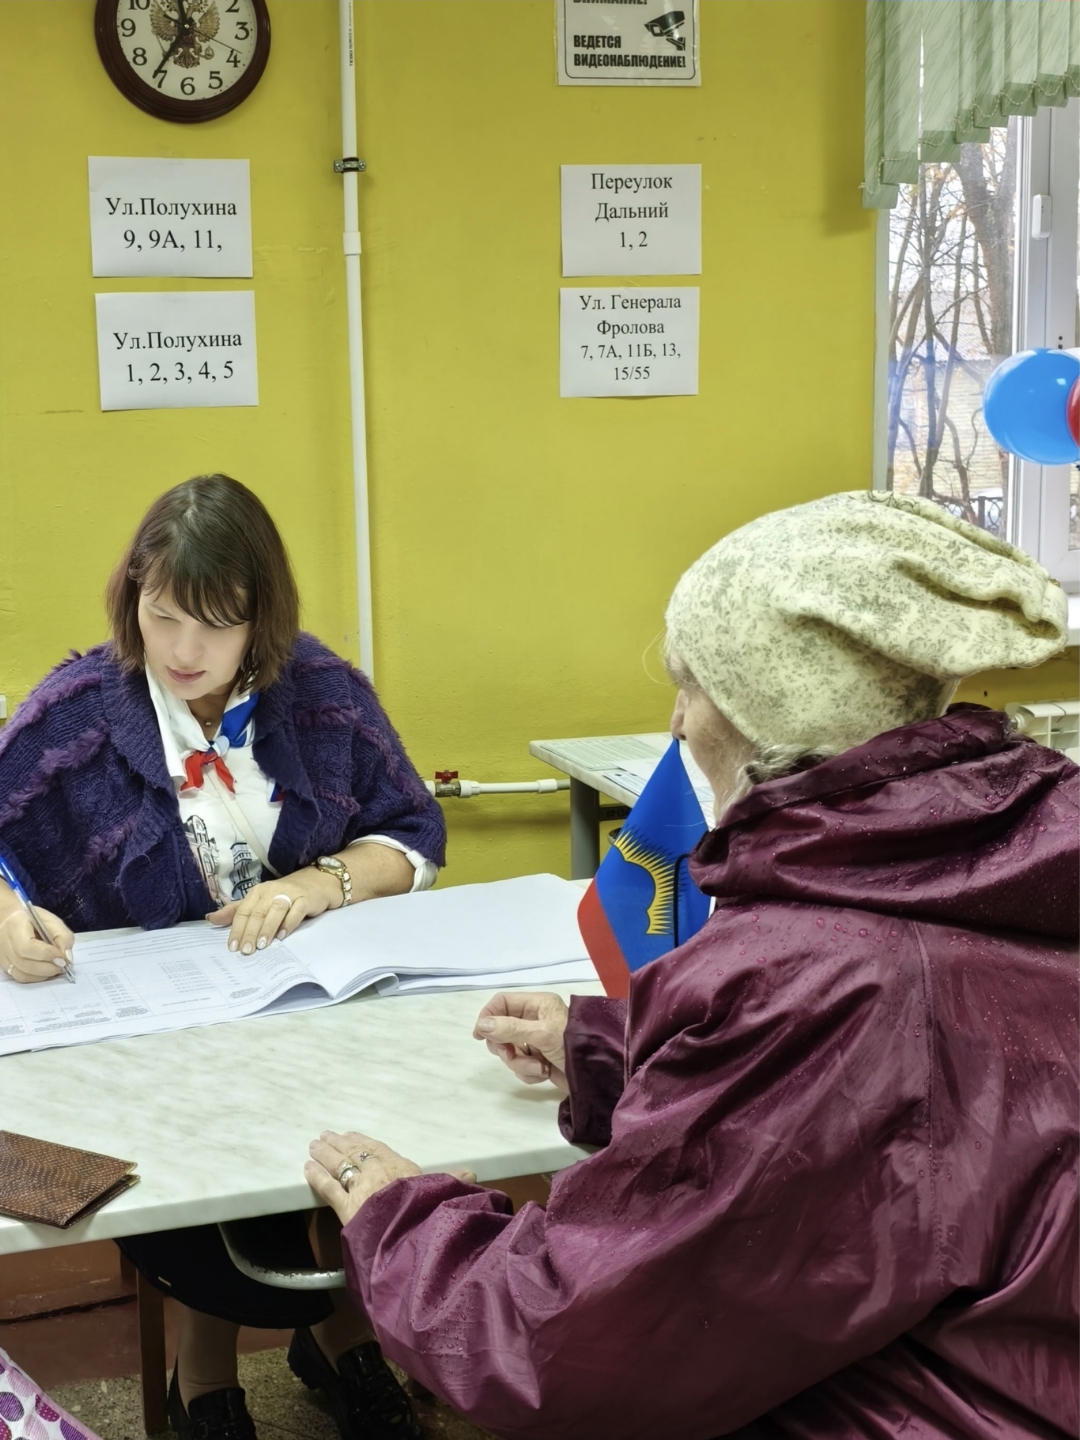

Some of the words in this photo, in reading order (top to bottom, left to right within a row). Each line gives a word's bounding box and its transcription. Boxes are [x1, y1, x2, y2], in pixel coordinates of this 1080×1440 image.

[120, 19, 136, 37] 9
[235, 22, 249, 40] 3
[573, 35, 621, 50] ВЕДЕТСЯ
[132, 48, 147, 65] 8
[226, 50, 241, 67] 4
[574, 54, 686, 69] ВИДЕОНАБЛЮДЕНИЕ!
[180, 77, 195, 95] 6
[208, 71, 223, 89] 5
[591, 173, 672, 194] Переулок
[105, 198, 237, 220] Ул.Полухина
[595, 202, 668, 222] Дальний
[123, 230, 142, 252] 9,
[149, 230, 185, 252] 9А,
[194, 230, 222, 252] 11,
[620, 232, 633, 250] 1,
[638, 231, 648, 247] 2
[579, 295, 605, 310] Ул.
[611, 295, 681, 313] Генерала
[597, 320, 664, 339] Фролова
[113, 332, 242, 352] Ул.Полухина
[581, 346, 593, 360] 7,
[598, 345, 622, 360] 7А,
[628, 344, 656, 358] 11Б,
[663, 343, 681, 358] 13,
[127, 364, 143, 385] 1,
[150, 363, 168, 384] 2,
[175, 362, 192, 384] 3,
[199, 361, 216, 383] 4,
[224, 361, 233, 379] 5
[615, 366, 650, 380] 15/55
